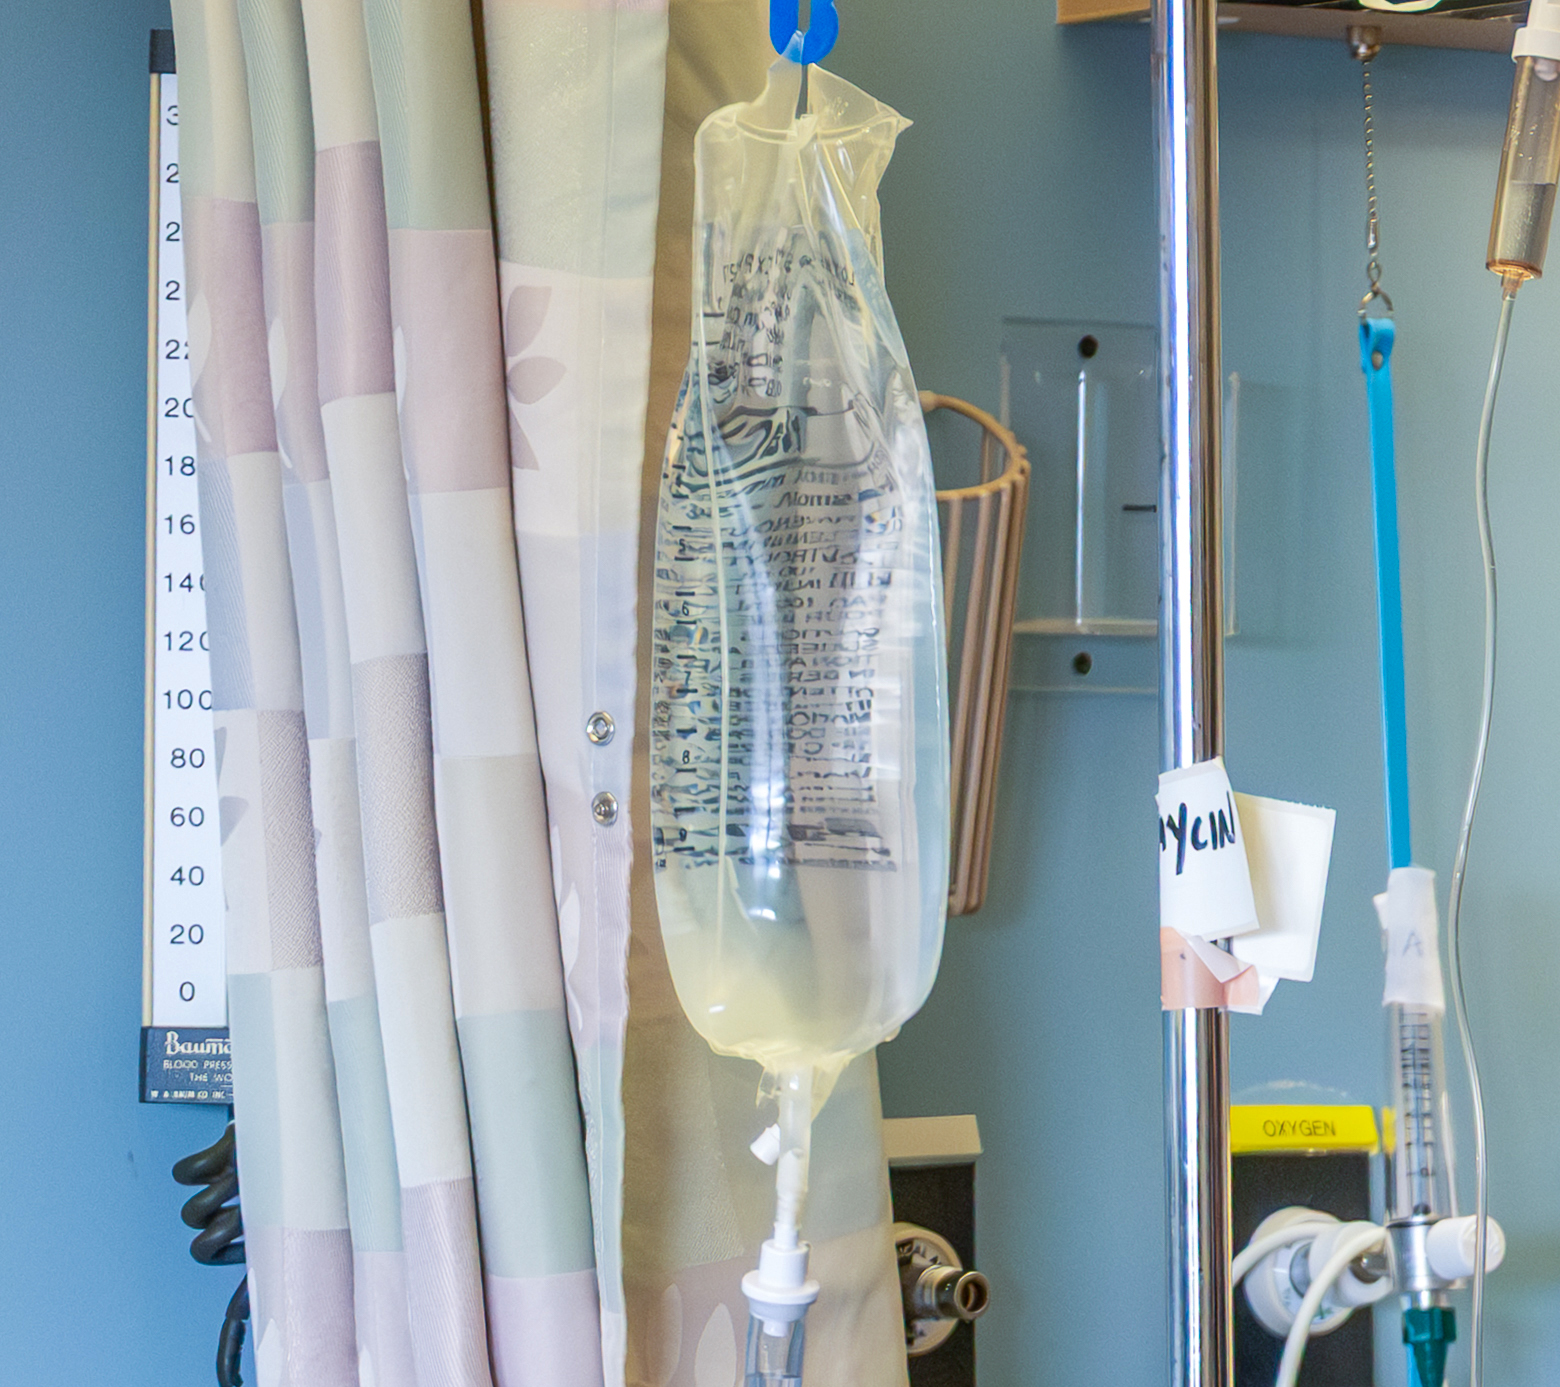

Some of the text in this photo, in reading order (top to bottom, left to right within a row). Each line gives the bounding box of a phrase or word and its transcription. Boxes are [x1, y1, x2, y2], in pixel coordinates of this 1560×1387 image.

[163, 689, 213, 710] 100
[170, 748, 206, 769] 80
[170, 807, 205, 827] 60
[170, 866, 205, 886] 40
[170, 924, 205, 945] 20
[179, 981, 195, 1002] 0
[1262, 1119, 1337, 1137] OXYGEN
